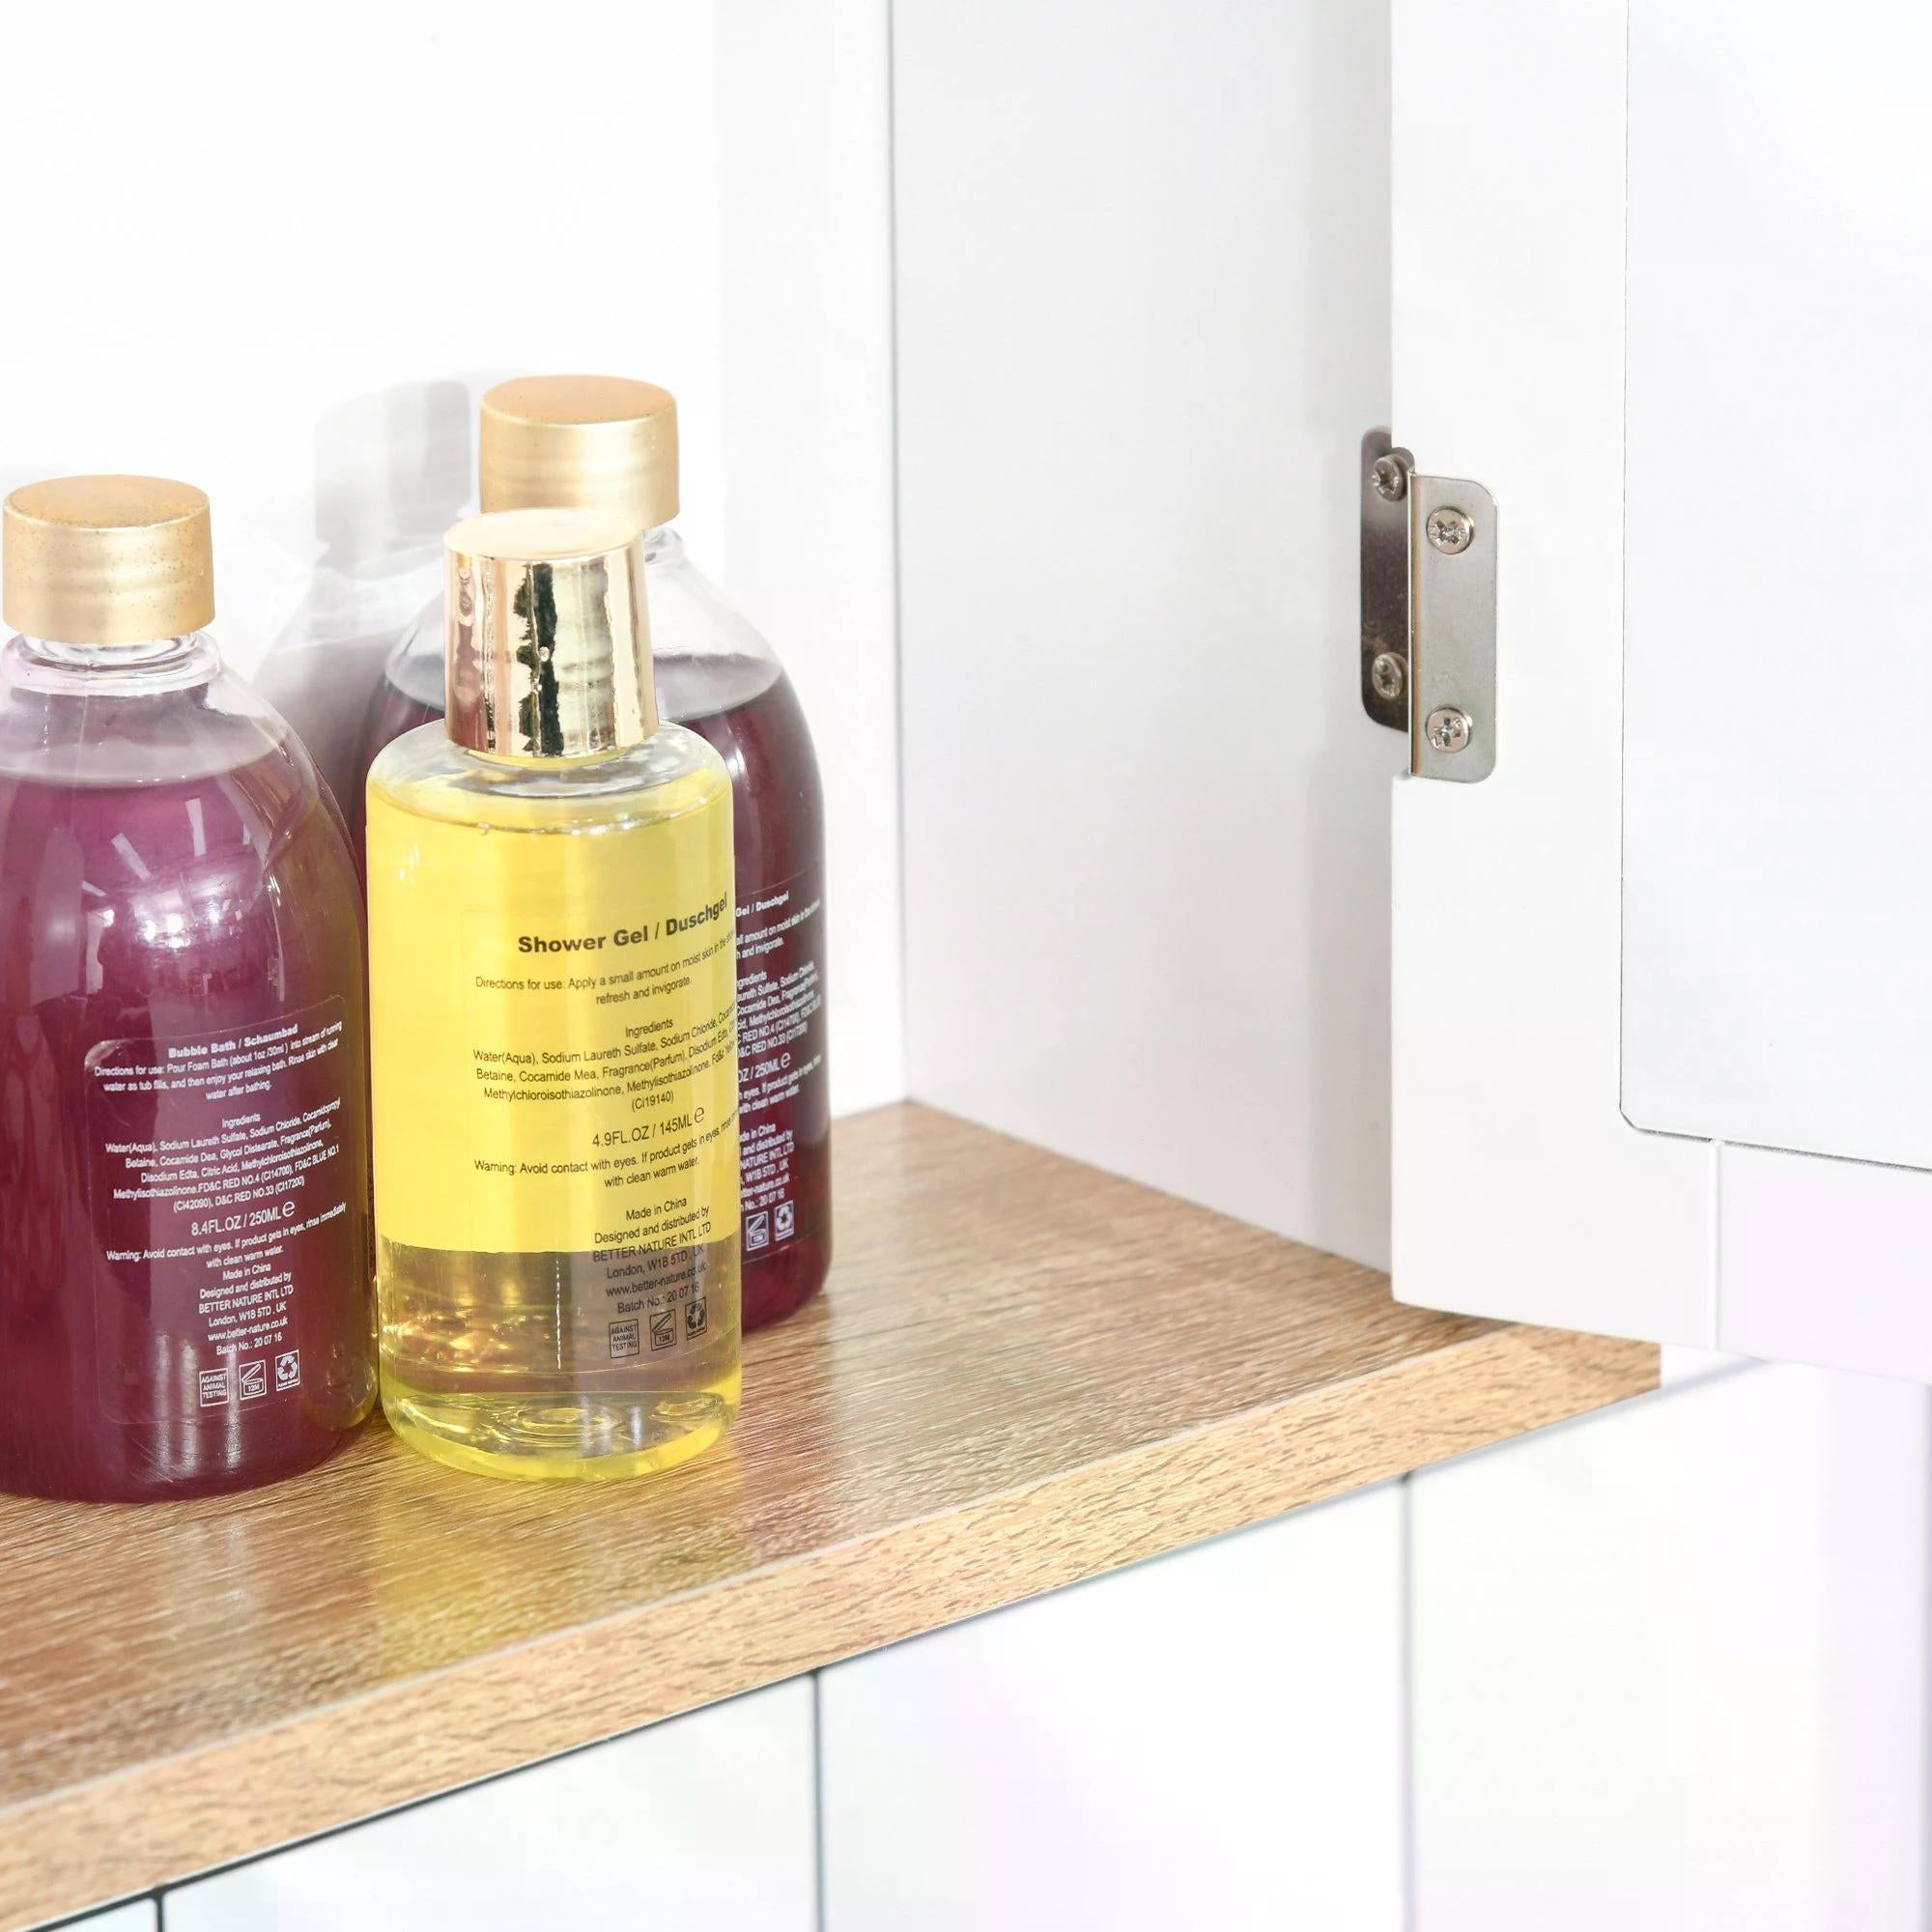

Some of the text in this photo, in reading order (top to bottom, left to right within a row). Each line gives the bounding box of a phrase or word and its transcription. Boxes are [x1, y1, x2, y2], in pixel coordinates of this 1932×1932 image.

[518, 935, 607, 952] Shower
[613, 924, 648, 946] Gel
[666, 891, 727, 936] Duschgel
[742, 946, 754, 958] and
[475, 976, 525, 990] Directions
[527, 979, 541, 990] for
[568, 976, 596, 990] Apply
[599, 977, 606, 986] a
[609, 971, 634, 984] small
[637, 964, 668, 980] amount
[670, 960, 680, 971] on
[682, 952, 701, 968] moist
[596, 986, 649, 1005] refresh and
[625, 1017, 673, 1038] Ingredients
[742, 1029, 757, 1042] RED
[168, 1045, 209, 1059] Bubble
[211, 1040, 237, 1054] Bath
[243, 1023, 298, 1047] Schaumbad
[542, 1052, 581, 1064] Sodium
[583, 1046, 621, 1062] Laureth
[660, 1031, 690, 1048] Sodium
[752, 1040, 767, 1054] RED
[94, 1065, 134, 1077] Directions
[135, 1065, 147, 1075] for
[167, 1064, 185, 1073] Pour
[187, 1062, 209, 1071] Foam
[211, 1058, 228, 1068] Bath
[519, 1070, 571, 1082] Cocamide
[688, 1037, 717, 1058] Disodium
[754, 1058, 780, 1078] 250ML
[171, 1078, 185, 1089] and
[187, 1077, 205, 1087] then
[206, 1075, 226, 1086] enjoy
[228, 1071, 243, 1083] your
[206, 1090, 226, 1100] water
[228, 1087, 244, 1096] after
[222, 1114, 261, 1129] Ingredients
[592, 1125, 649, 1147] 4.9FL.OZ
[660, 1114, 693, 1135] 145ML
[758, 1123, 777, 1137] China
[159, 1140, 189, 1151] Sodium
[249, 1124, 274, 1138] Sodium
[159, 1147, 242, 1166] Cocamide Glycol
[520, 1162, 548, 1174] Avoid
[551, 1160, 588, 1174] contact
[591, 1158, 611, 1171] with
[641, 1151, 648, 1163] If
[649, 1143, 681, 1163] product
[682, 1139, 697, 1154] gets
[698, 1135, 705, 1146] in
[742, 1143, 755, 1156] and
[222, 1179, 240, 1189] RED
[312, 1151, 327, 1165] BLUE
[741, 1151, 769, 1170] NATURE
[780, 1157, 789, 1171] UK
[141, 1166, 220, 1182] Disodium Citric
[604, 1176, 624, 1187] with
[626, 1171, 651, 1184] clean
[653, 1165, 676, 1179] warm
[215, 1183, 274, 1207] D&C RED NO.33
[626, 1197, 687, 1221] Made in China
[191, 1215, 241, 1236] 8.4FL.OZ
[249, 1206, 281, 1227] 250ML
[594, 1206, 710, 1244] Designed and distributed by
[143, 1249, 165, 1259] Avoid
[166, 1246, 195, 1258] contact
[196, 1243, 212, 1255] with
[235, 1238, 241, 1248] If
[242, 1233, 267, 1249] product
[283, 1227, 289, 1236] in
[593, 1245, 637, 1263] BETTER
[638, 1237, 677, 1255] NATURE
[697, 1221, 711, 1237] LTD
[206, 1250, 263, 1268] with clean warm
[647, 1256, 668, 1270] W1B
[670, 1250, 688, 1264] 5TD
[222, 1264, 271, 1280] Made in China
[200, 1272, 292, 1299] Designed and distributed by
[198, 1299, 231, 1314] BETTER
[232, 1293, 263, 1308] NATURE
[280, 1285, 294, 1297] LTD
[617, 1282, 699, 1314] Batch 20 07 16
[257, 1306, 271, 1318] 5TD
[276, 1300, 287, 1314] UK
[611, 1323, 638, 1334] AGAINST
[612, 1333, 637, 1343] ANIMAL
[216, 1331, 282, 1355] Batch 20 07 16
[611, 1342, 638, 1351] TESTING
[201, 1373, 226, 1383] AGAINST
[203, 1382, 226, 1391] ANIMAL
[202, 1390, 227, 1399] TESTING
